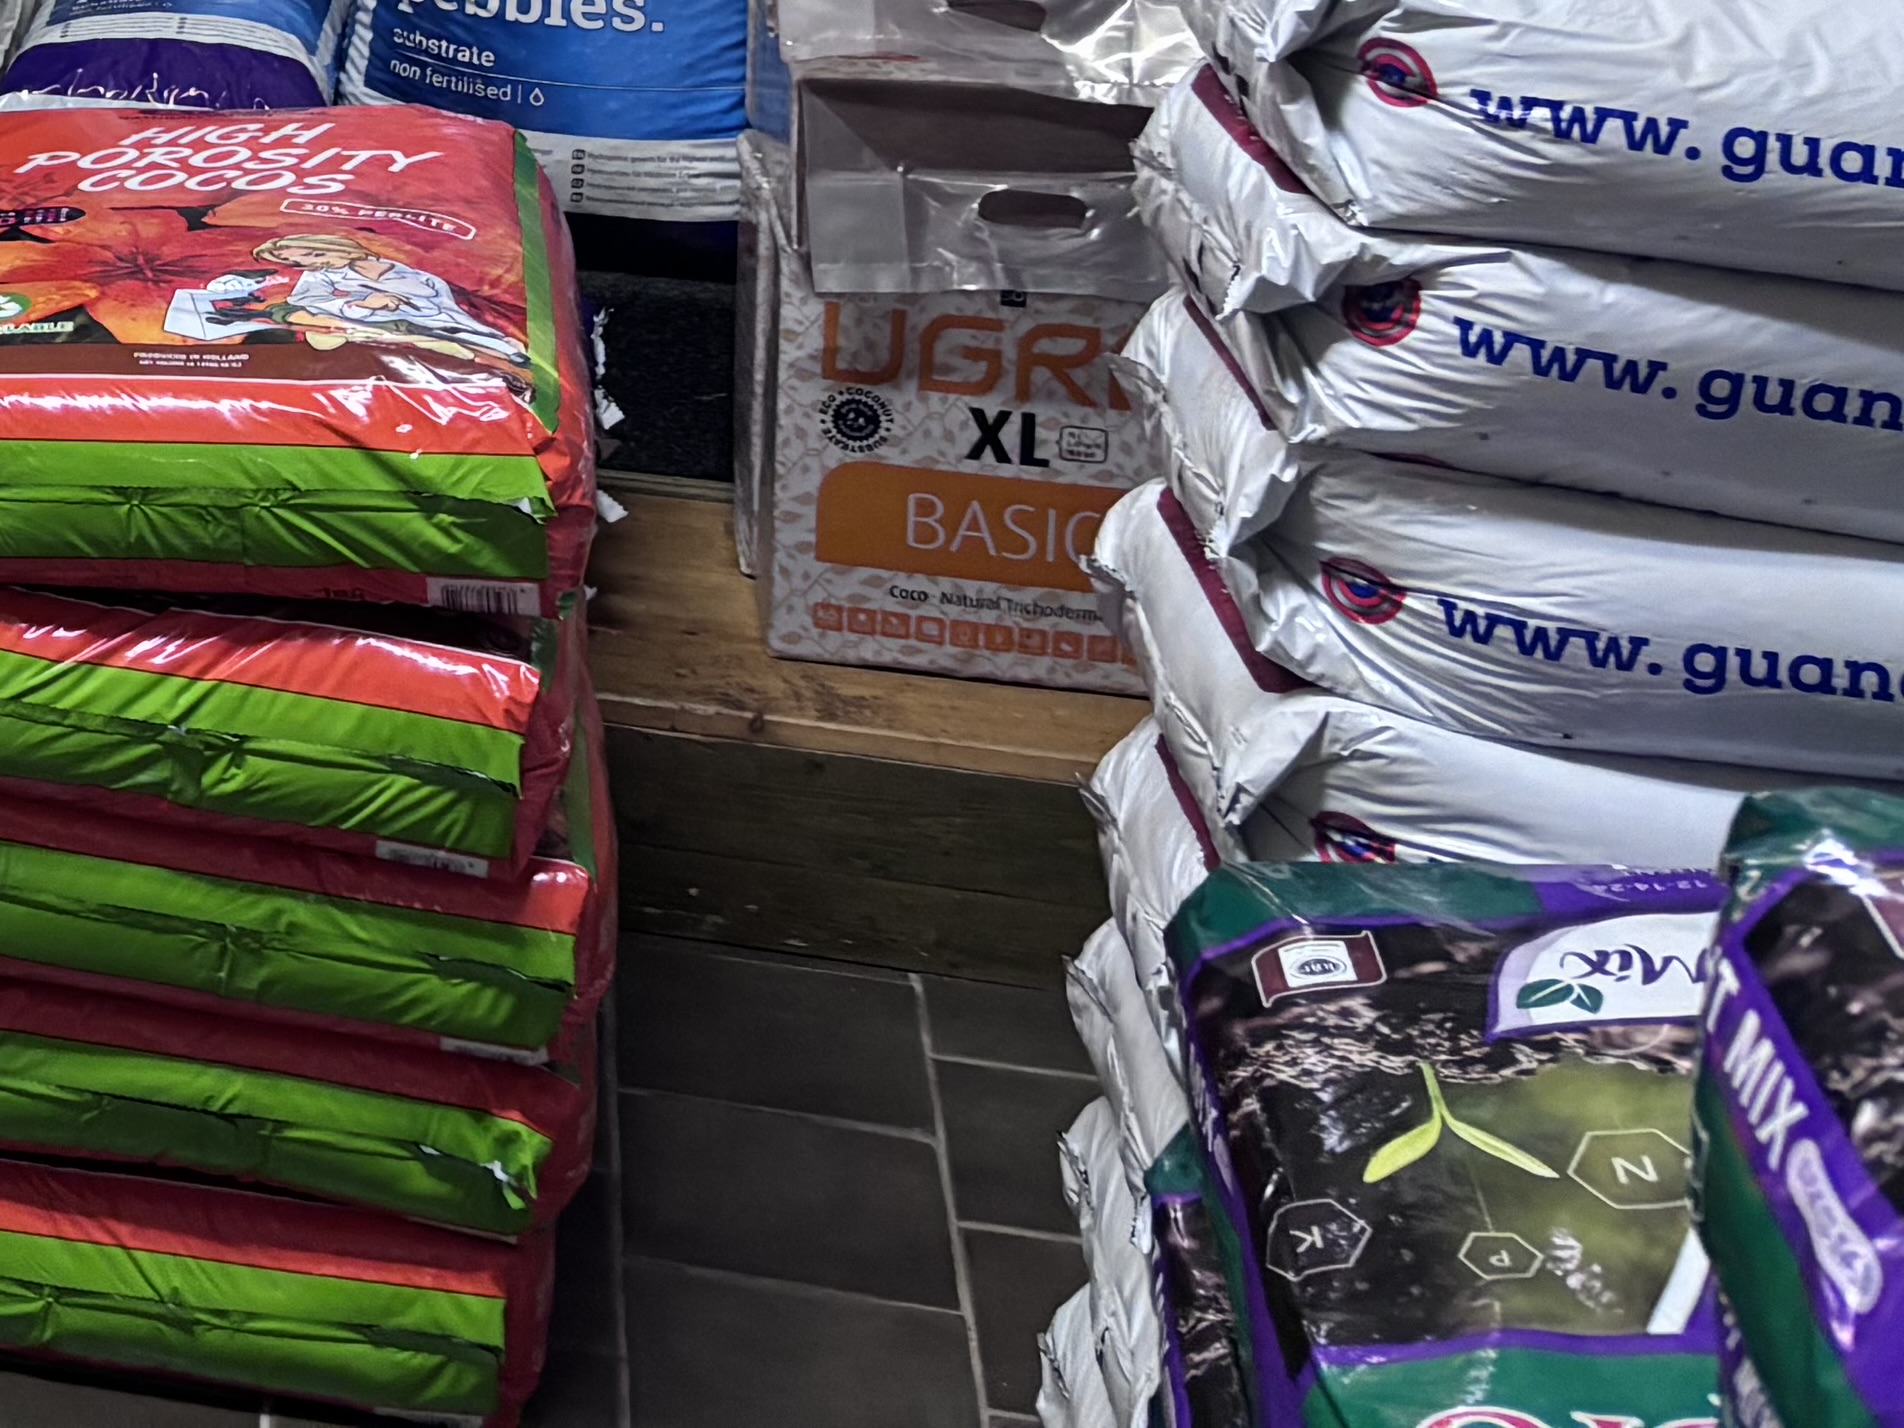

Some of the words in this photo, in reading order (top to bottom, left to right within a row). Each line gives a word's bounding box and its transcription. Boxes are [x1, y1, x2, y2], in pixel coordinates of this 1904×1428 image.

[392, 28, 496, 69] substrate
[390, 59, 420, 82] non
[424, 64, 512, 103] fertilised
[121, 121, 336, 146] HIGH
[14, 144, 446, 174] POROSITY
[75, 165, 357, 195] COCOS
[963, 406, 1051, 469] XL
[1723, 1009, 1811, 1171] MIX
